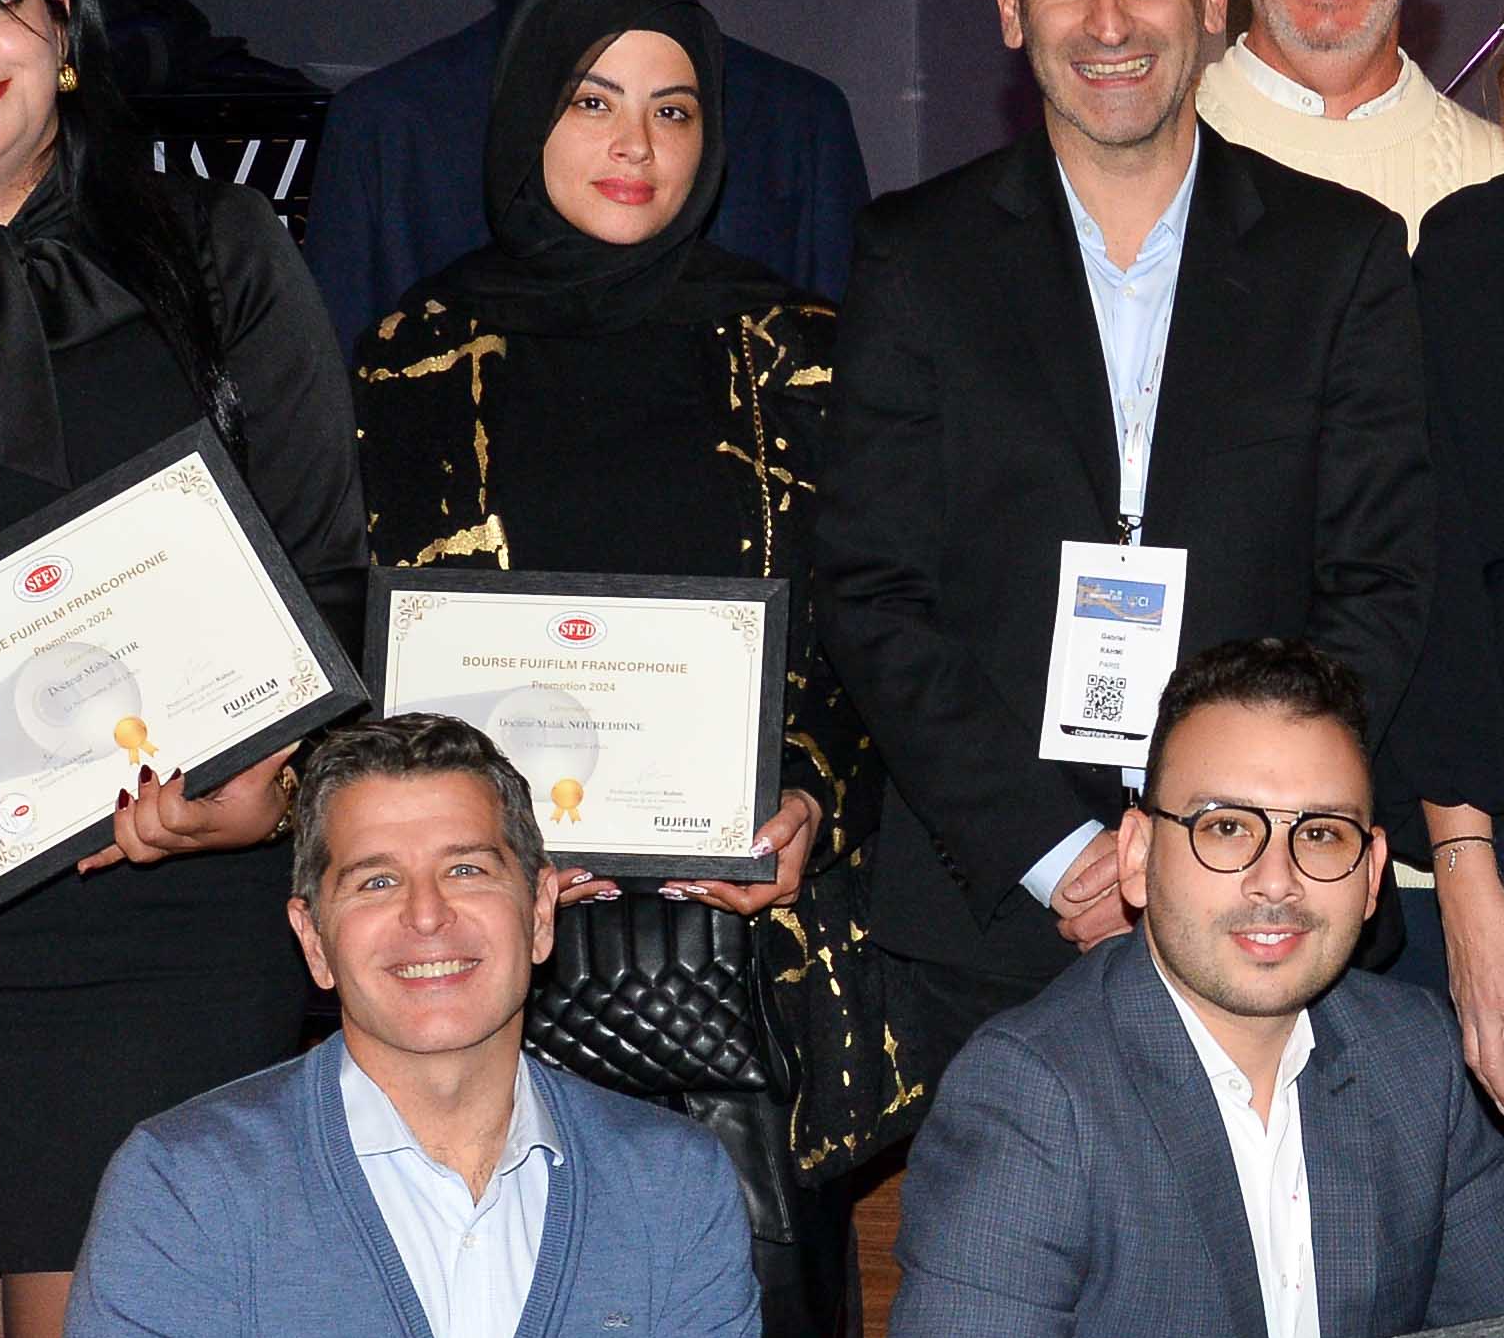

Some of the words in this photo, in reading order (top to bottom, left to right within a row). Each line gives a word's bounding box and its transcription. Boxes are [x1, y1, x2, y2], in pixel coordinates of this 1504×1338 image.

[26, 566, 61, 592] SFED
[9, 607, 67, 644] FUJIFILM
[67, 550, 169, 613] FRANCOPHONIE
[33, 622, 87, 656] Promotion
[87, 607, 114, 628] 2024
[558, 622, 595, 637] SFED
[462, 656, 516, 668] BOURSE
[519, 658, 578, 670] FUJIFILM
[581, 660, 688, 674] FRANCOPHONIE
[531, 680, 587, 692] Promotion
[588, 682, 616, 692] 2024
[222, 677, 279, 715] FUJIFILM
[568, 721, 643, 732] NOUREDDINE
[653, 816, 711, 828] FUJIFILM
